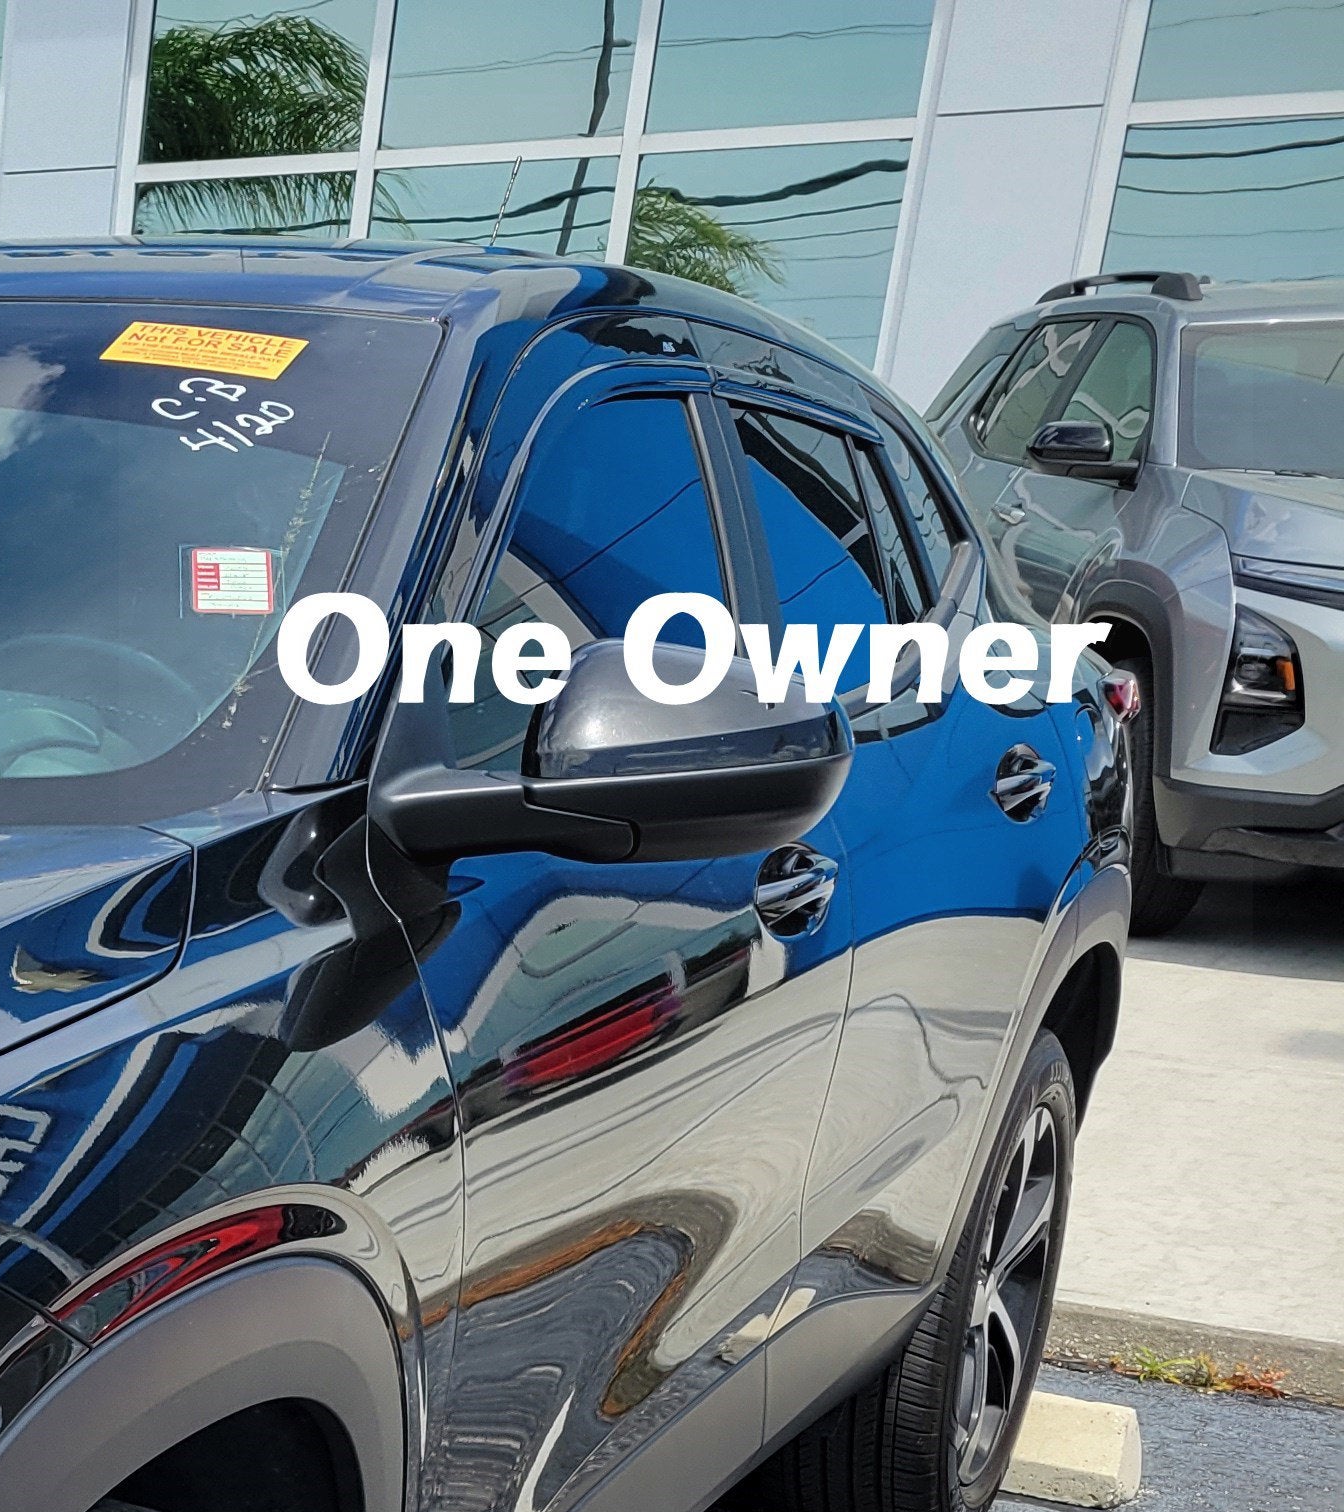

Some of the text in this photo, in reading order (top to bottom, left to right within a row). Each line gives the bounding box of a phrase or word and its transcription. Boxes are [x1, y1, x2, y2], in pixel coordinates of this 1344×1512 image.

[128, 333, 167, 343] Not
[172, 336, 222, 348] FOR
[227, 343, 293, 358] SALE
[138, 325, 297, 349] THIS VEHICLE
[179, 400, 295, 453] 4/20
